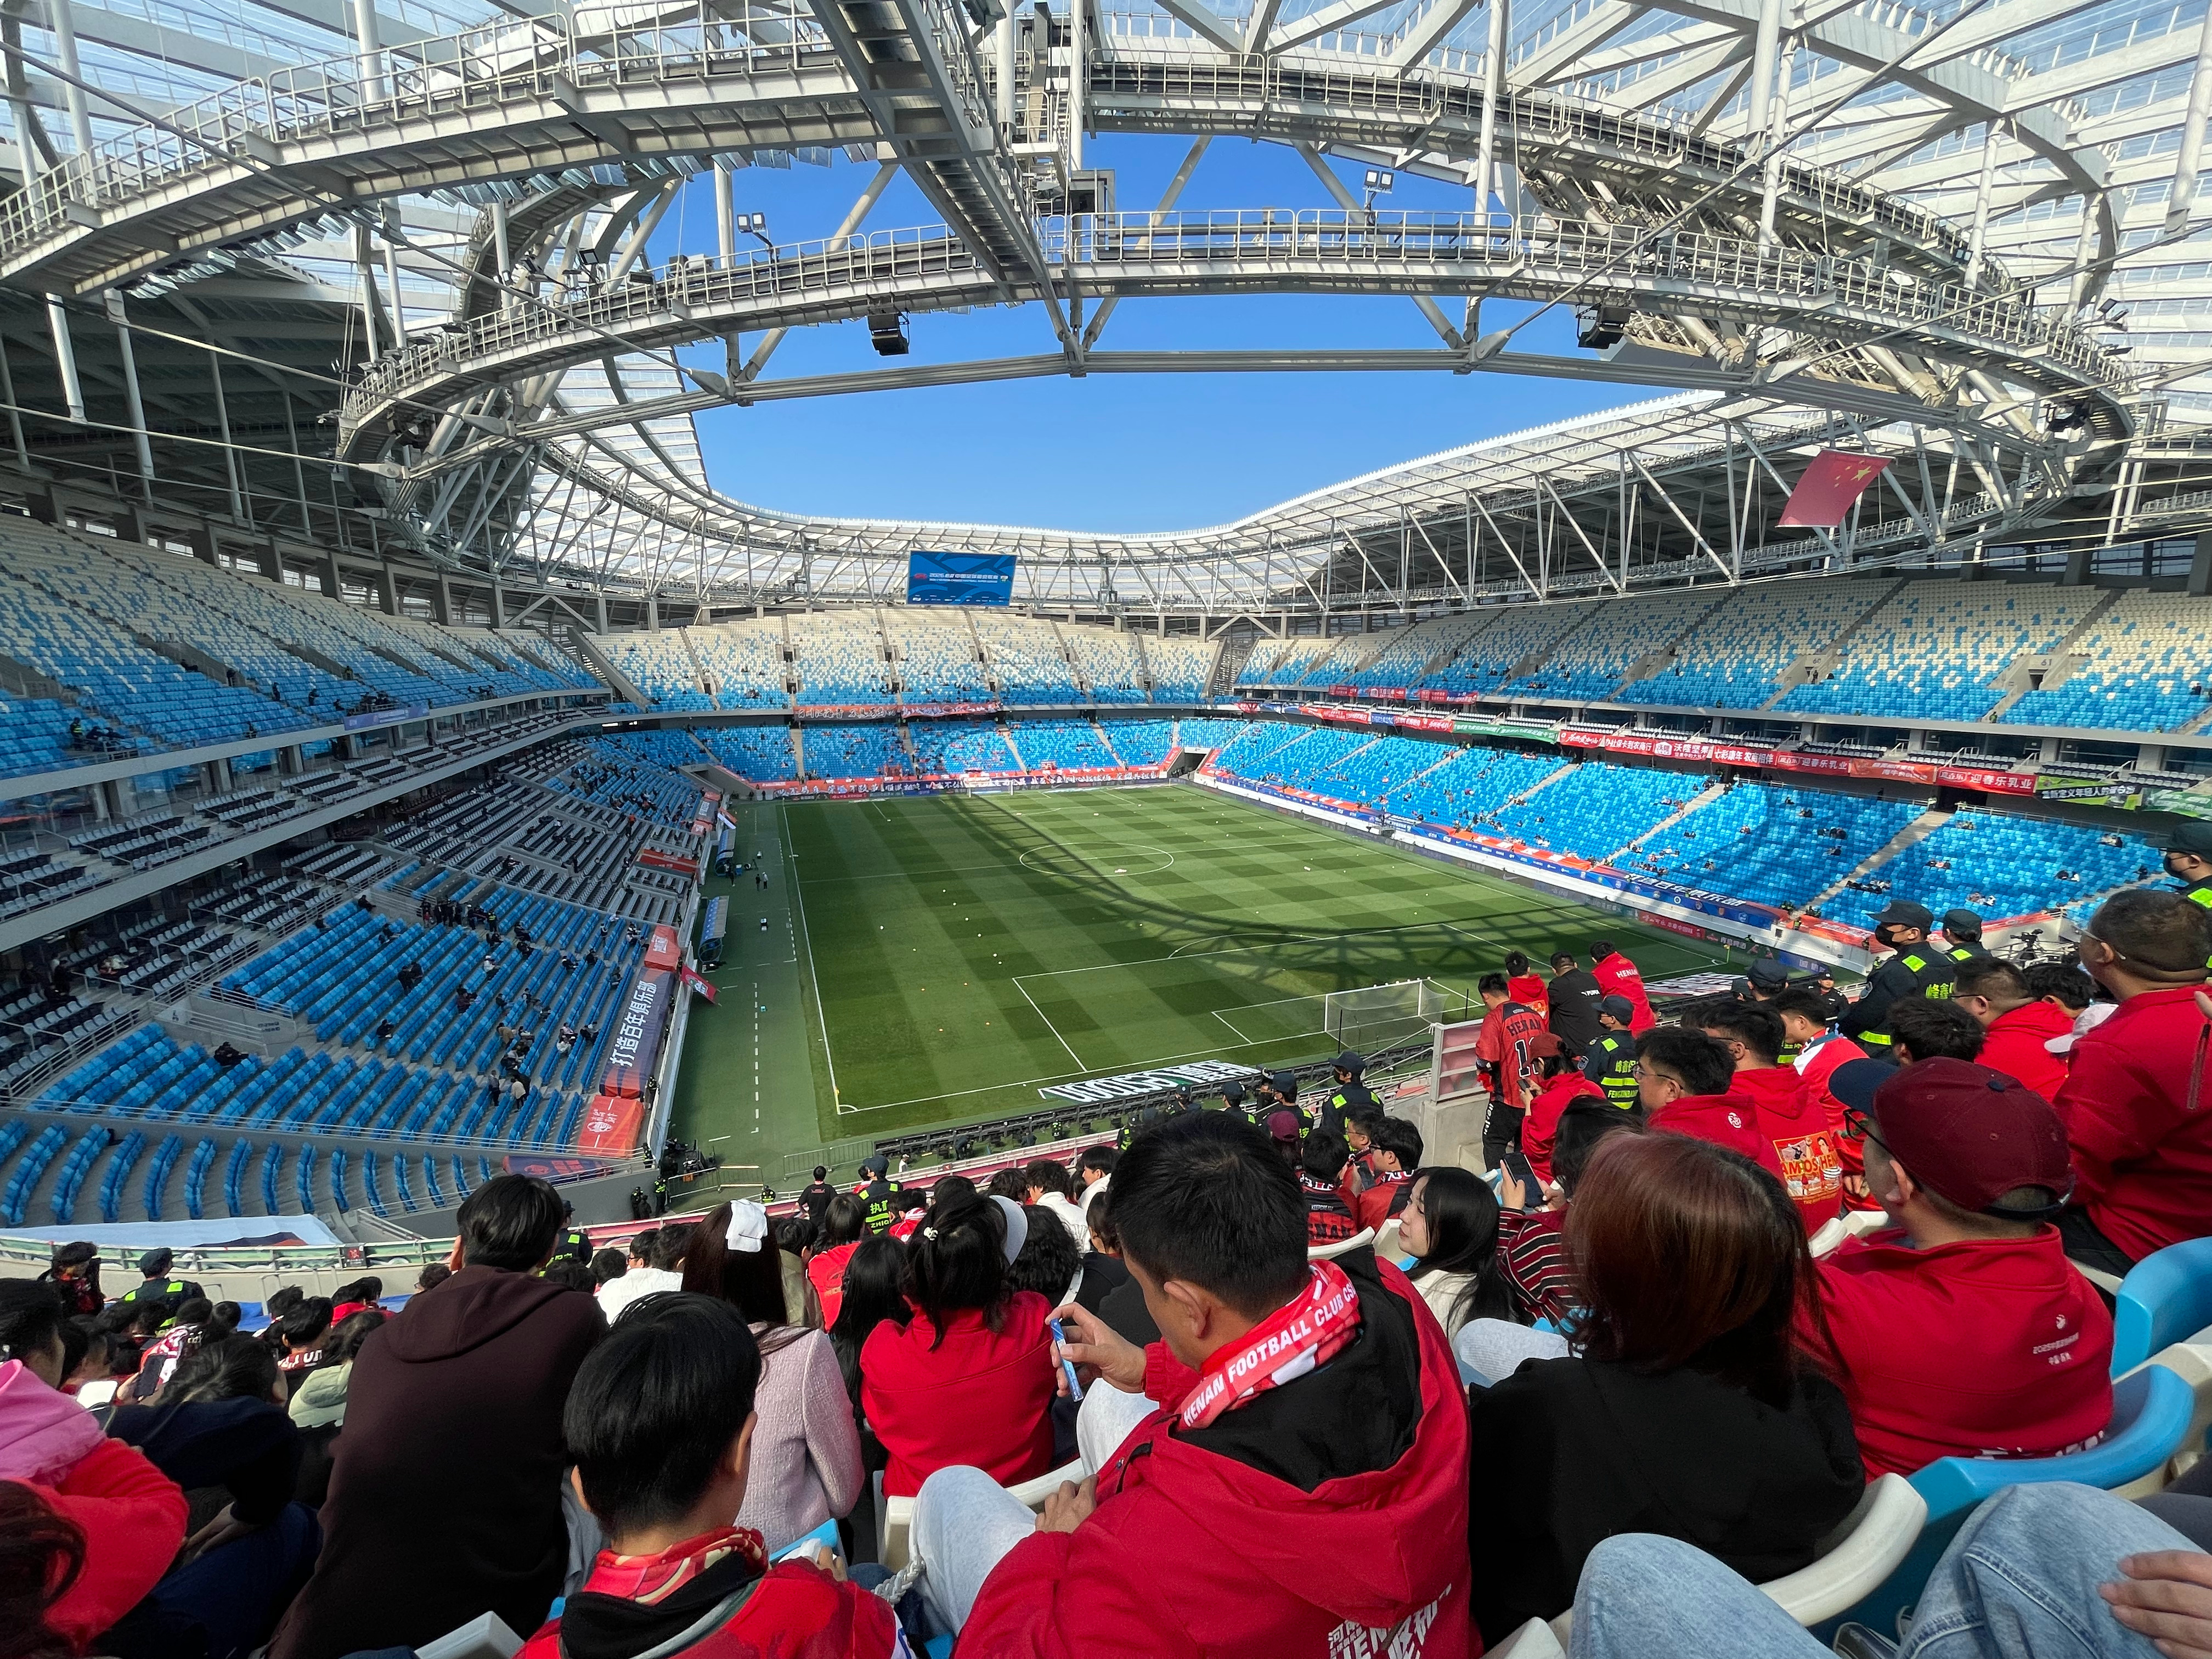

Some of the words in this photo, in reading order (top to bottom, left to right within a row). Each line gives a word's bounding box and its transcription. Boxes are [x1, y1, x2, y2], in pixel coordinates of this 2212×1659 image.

[1970, 774, 2032, 789] 迎春乐乳业
[1616, 968, 1639, 979] HENAN
[1926, 983, 1954, 999] 峰鑫
[610, 980, 657, 1068] 打造百年俱乐部
[1781, 1158, 1818, 1175] AMOS
[871, 1220, 889, 1228] ZHIQ
[1183, 1374, 1225, 1427] HENAN
[1227, 1320, 1311, 1383] FOOTBALL
[1314, 1293, 1344, 1327] CLUB
